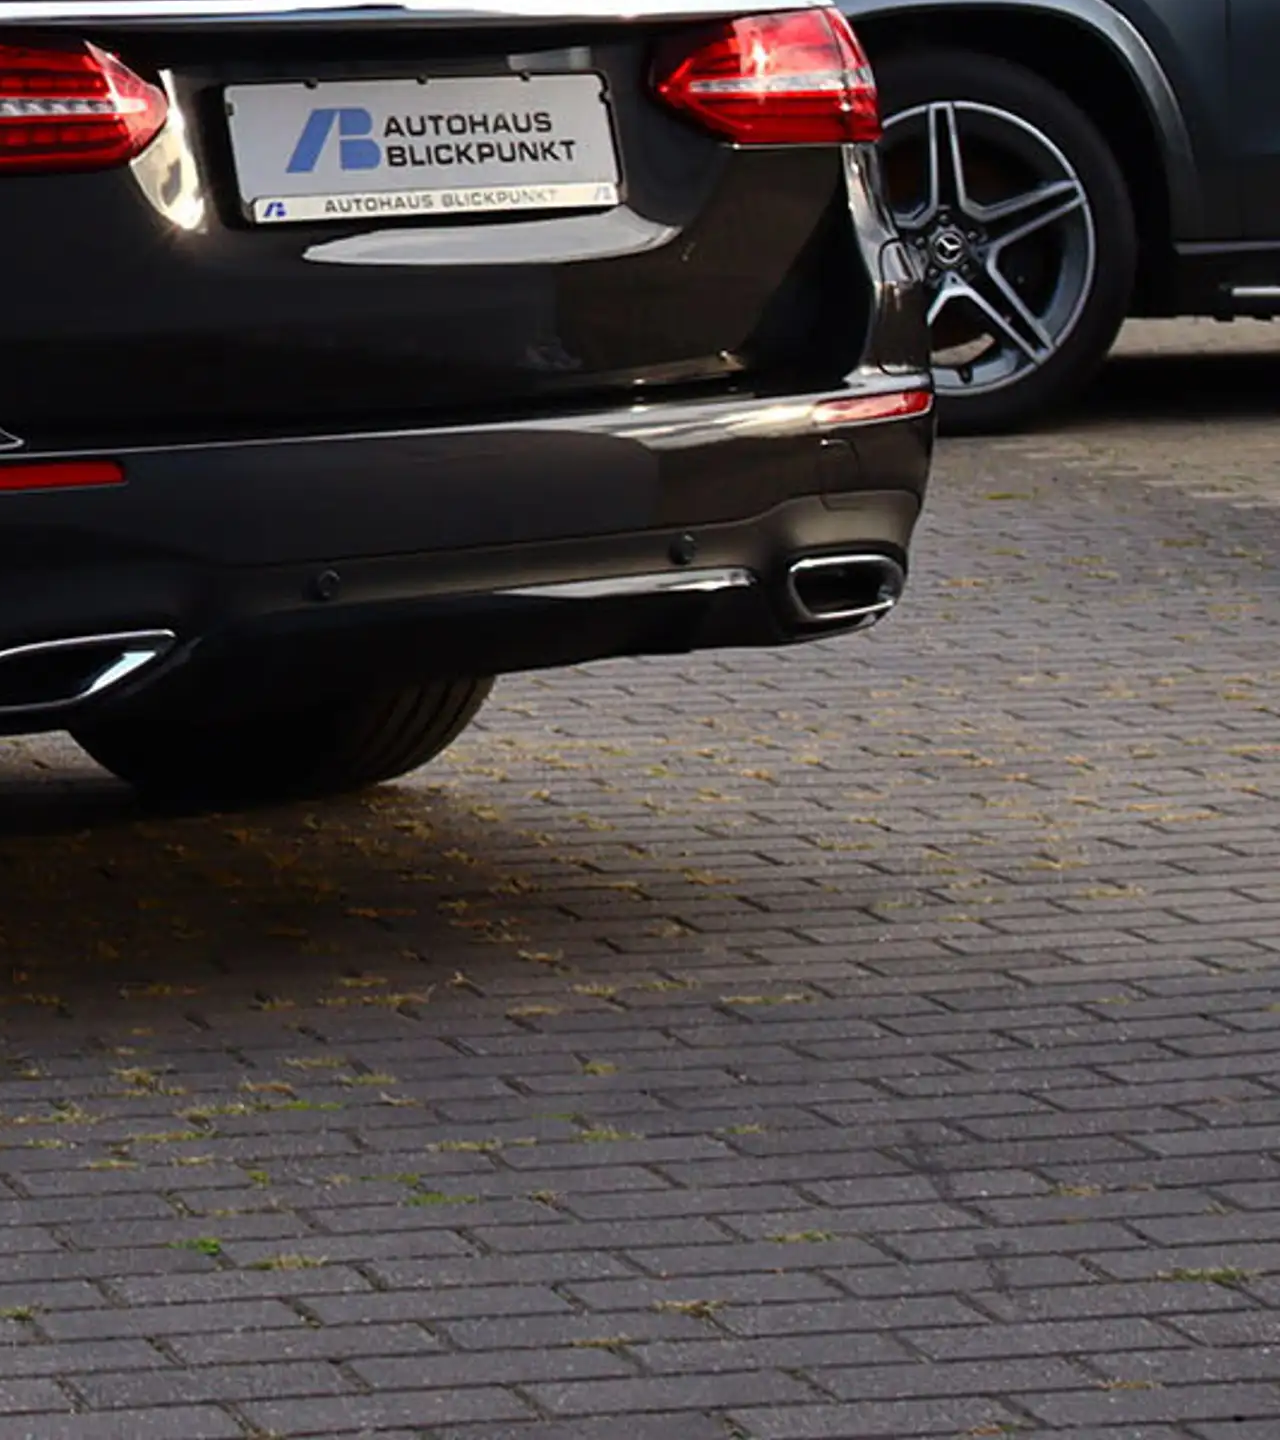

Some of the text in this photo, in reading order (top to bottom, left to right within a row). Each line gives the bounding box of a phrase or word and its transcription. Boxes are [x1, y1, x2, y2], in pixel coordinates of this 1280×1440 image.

[383, 112, 553, 138] AUTOHAUS
[386, 140, 577, 168] BLICKPUNKT
[324, 192, 435, 213] AUTOHAUS
[442, 188, 558, 208] BLICKPUNKT
